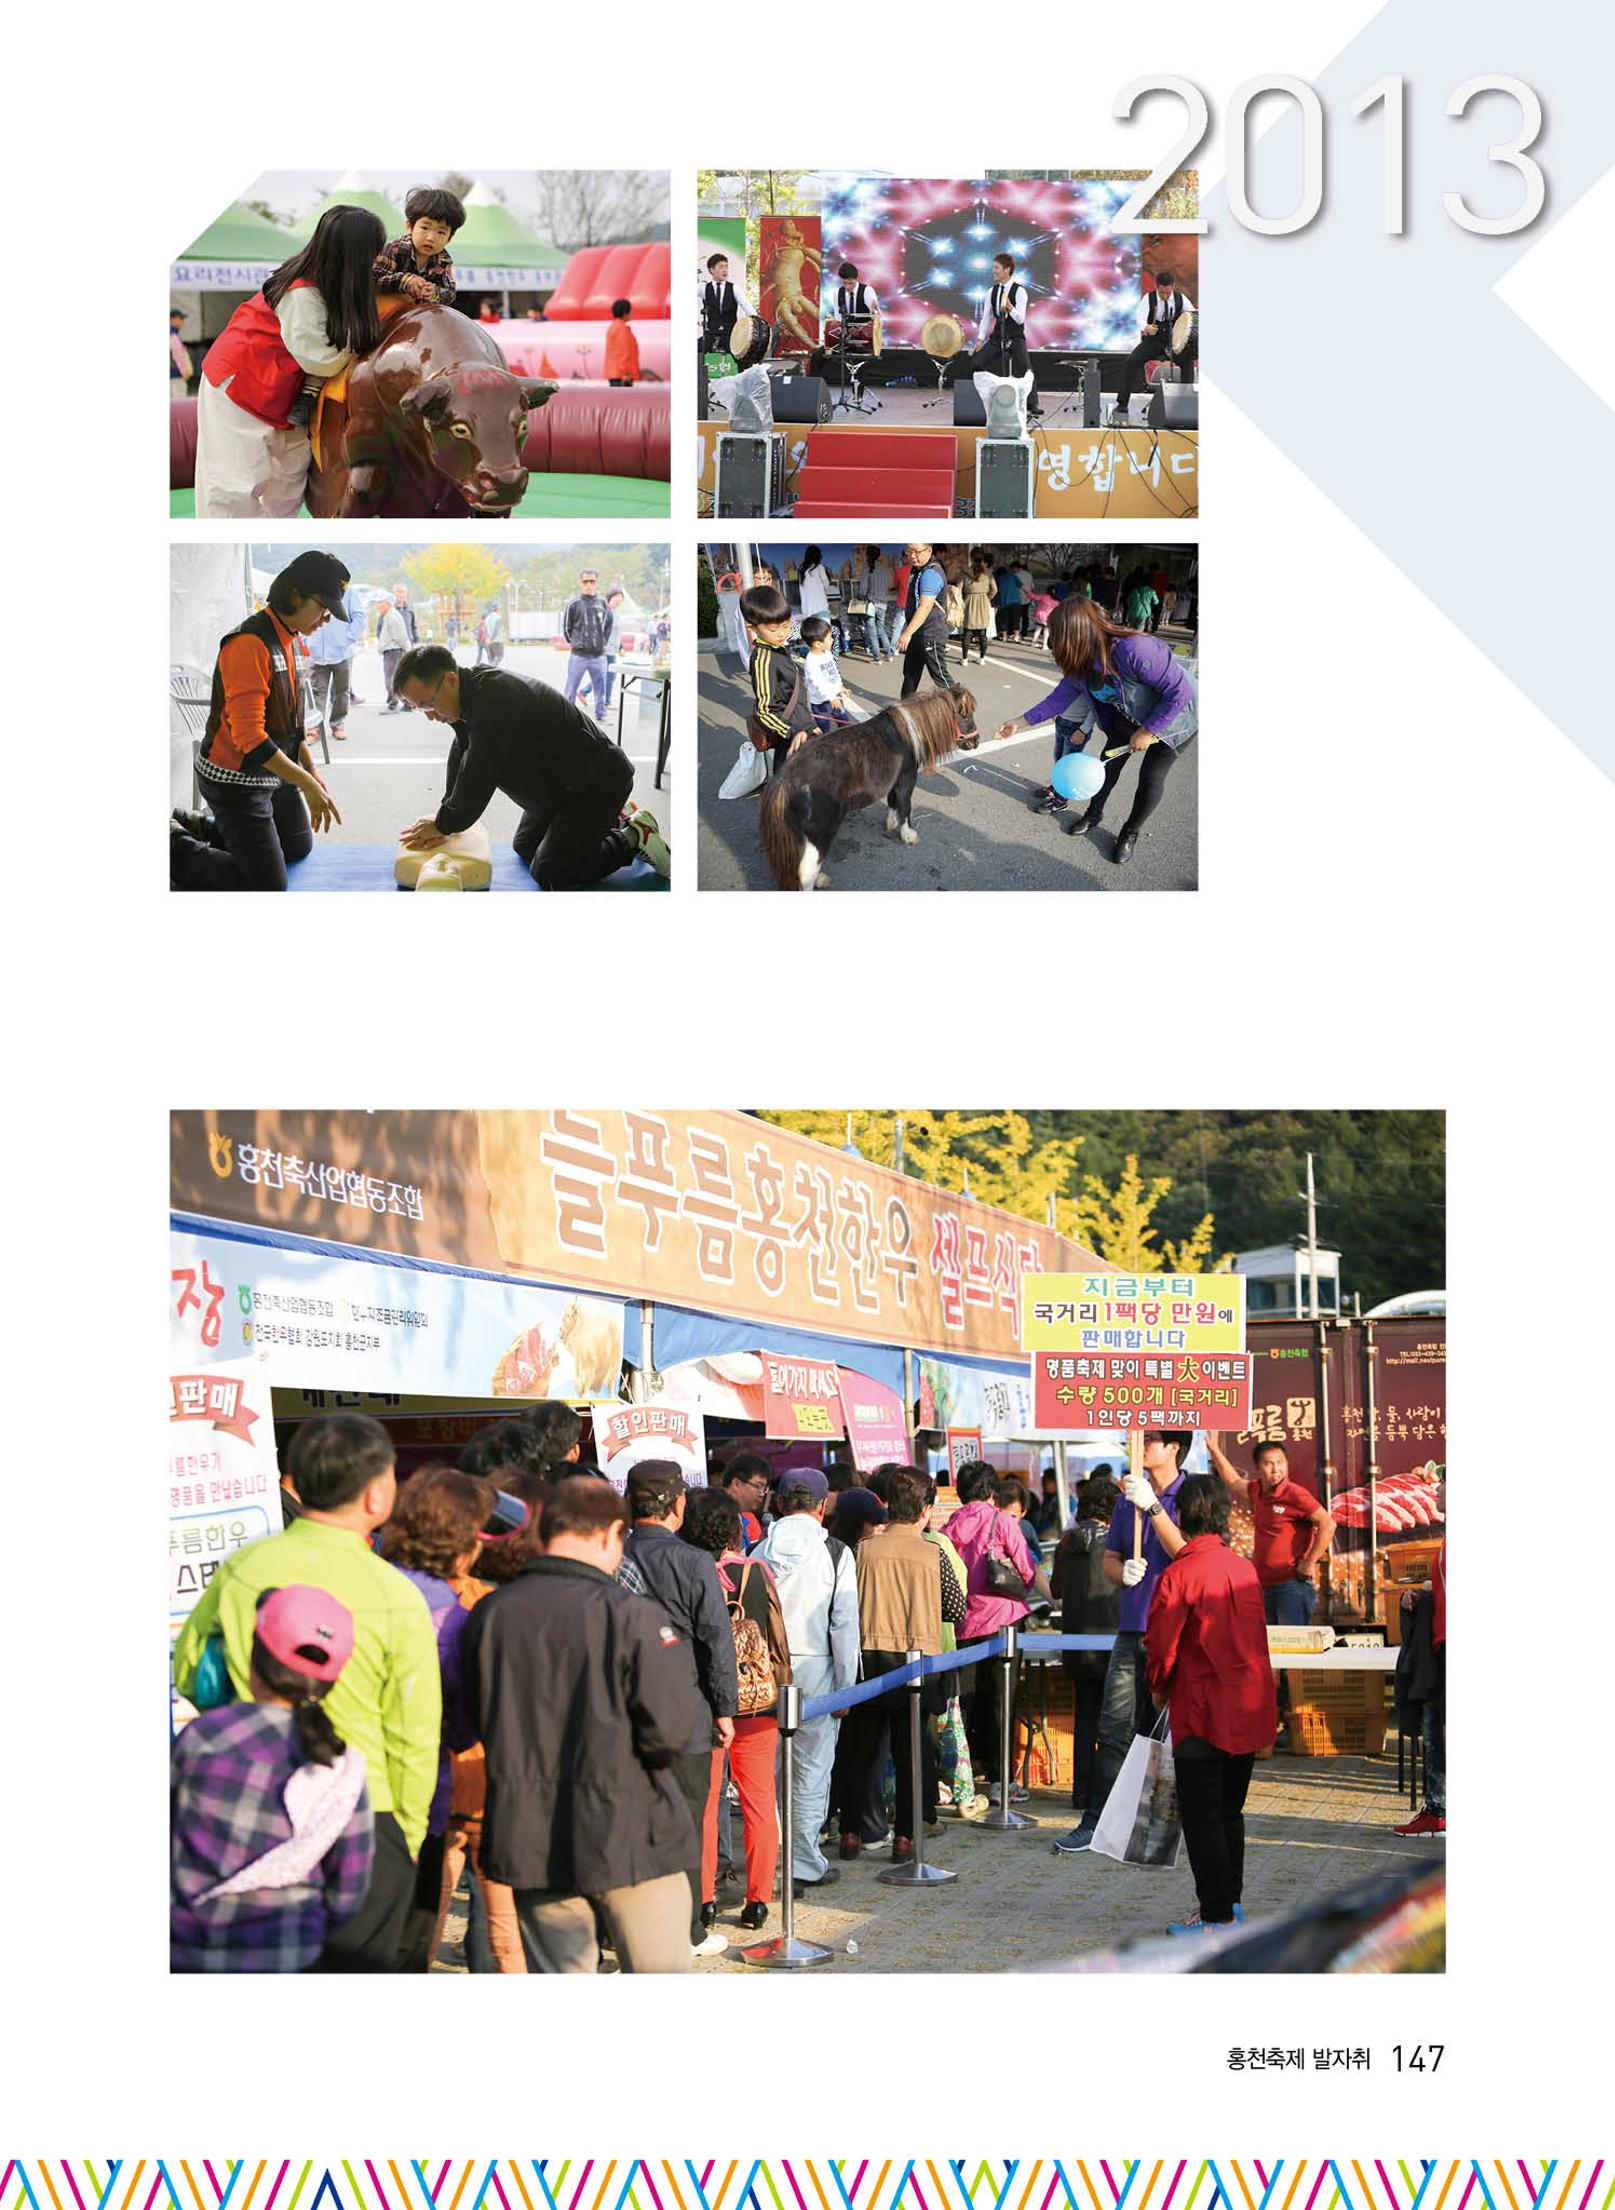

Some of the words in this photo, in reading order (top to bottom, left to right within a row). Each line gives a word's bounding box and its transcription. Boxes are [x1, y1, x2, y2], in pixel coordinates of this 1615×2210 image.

[237, 1143, 424, 1221] 홍천축산업협동조합
[540, 1110, 919, 1314] 늘푸름홍천한우
[1084, 1278, 1194, 1297] 지금부터
[1035, 1303, 1098, 1323] 국거리
[1105, 1302, 1161, 1325] 1팩당
[1171, 1302, 1233, 1324] 만원에
[1081, 1329, 1186, 1349] 판매합니다
[1046, 1359, 1105, 1379] 명품축제
[1110, 1360, 1140, 1379] 맞이
[1144, 1360, 1174, 1380] 특별
[1177, 1357, 1200, 1382] 大
[1202, 1361, 1247, 1380] 이벤트
[1056, 1386, 1098, 1405] 수량
[1103, 1386, 1164, 1405] 500개
[1171, 1388, 1238, 1407] [국거리]
[611, 1411, 686, 1439] 할인판매
[1087, 1409, 1132, 1426] 1인당
[1138, 1410, 1200, 1427] 5팩까지
[1237, 1404, 1287, 1445] 푸름
